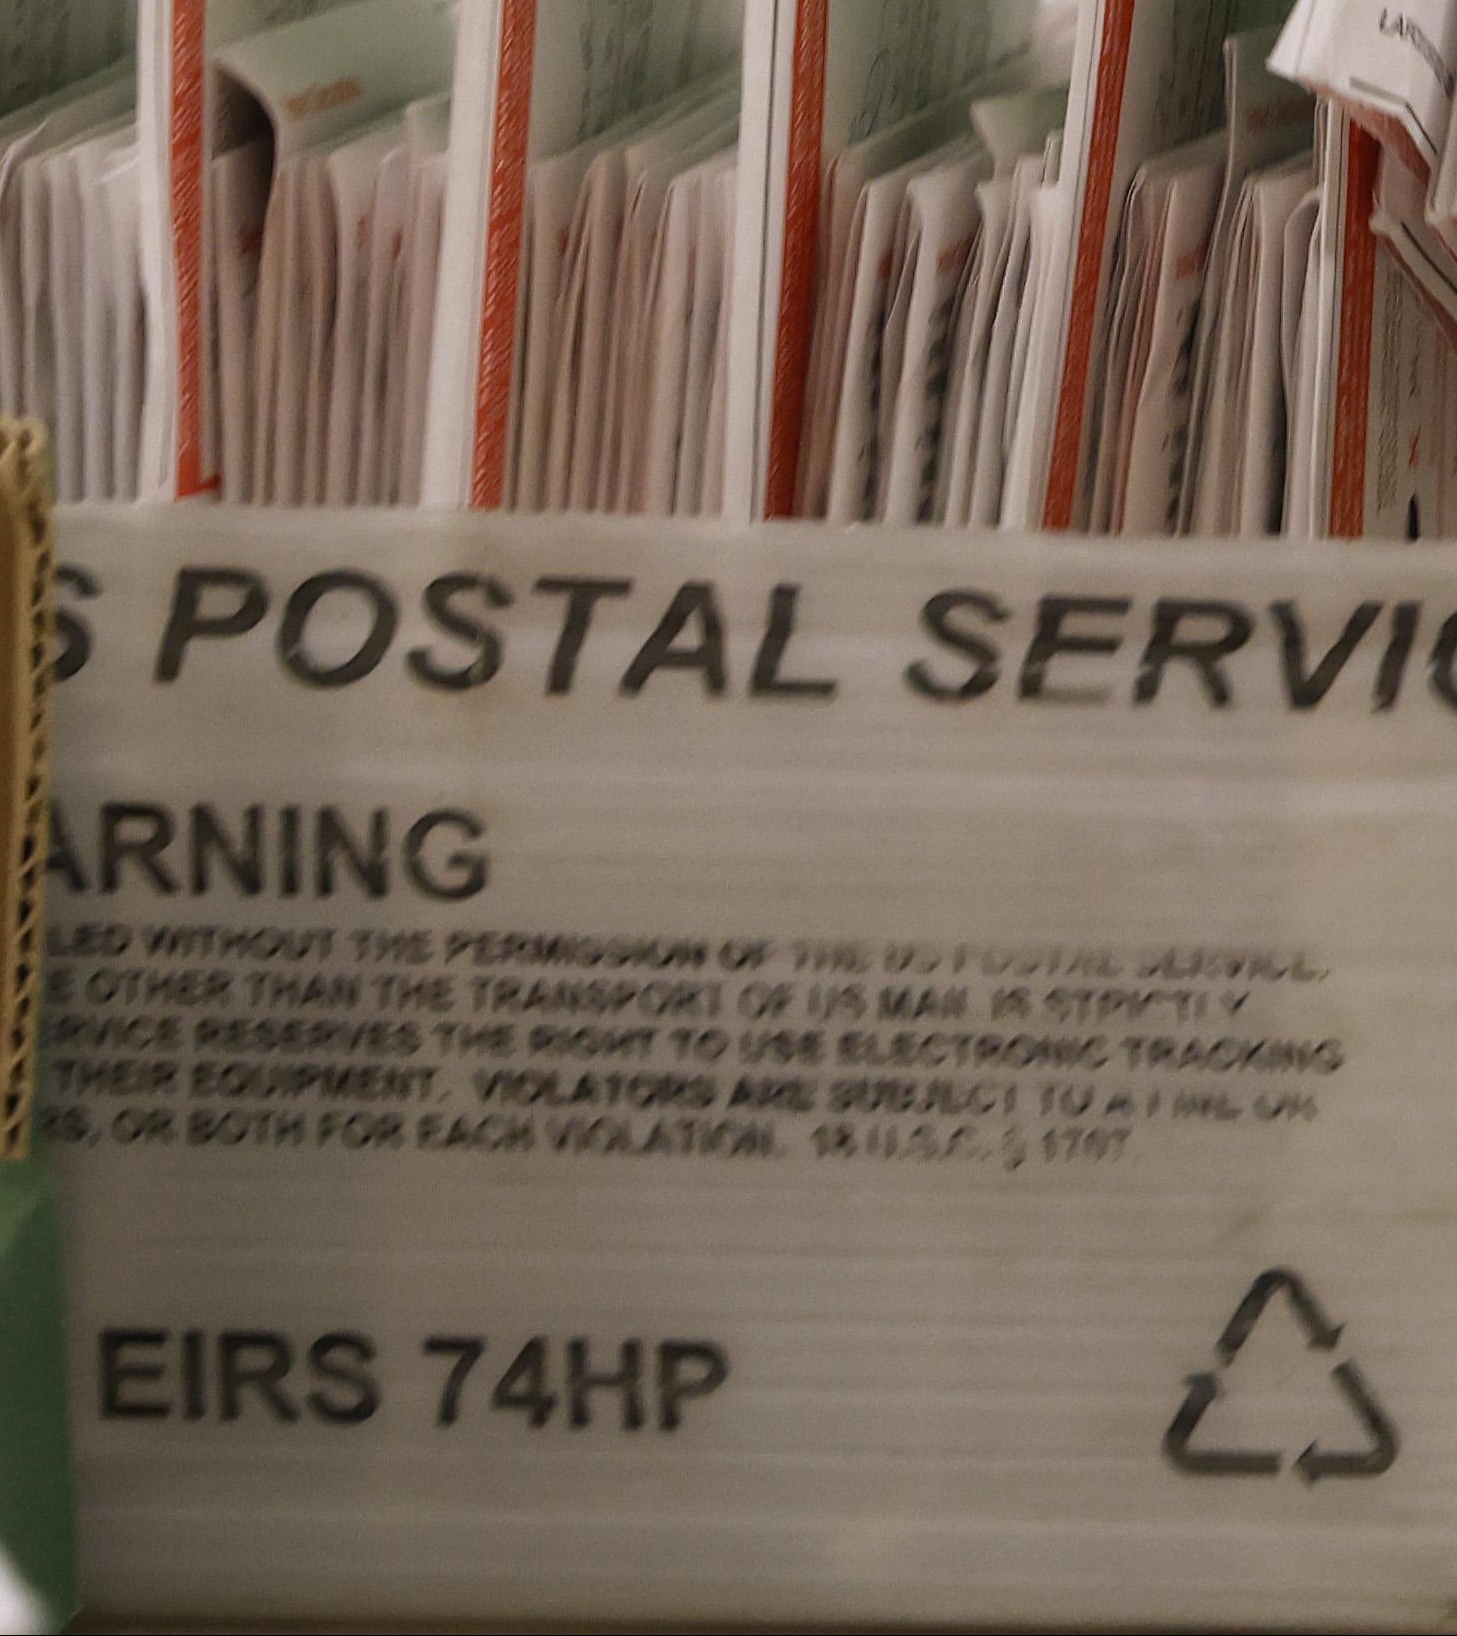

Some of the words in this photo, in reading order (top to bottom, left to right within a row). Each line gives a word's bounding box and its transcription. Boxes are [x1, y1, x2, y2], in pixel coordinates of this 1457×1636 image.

[154, 567, 839, 698] POSTAL
[145, 925, 340, 961] WITHOUT
[347, 928, 433, 964] THE
[444, 929, 711, 970] PERMISSION
[717, 935, 769, 971] OF
[85, 967, 235, 1007] OTHER
[245, 970, 361, 1009] THAN
[372, 972, 455, 1013] THE
[472, 975, 723, 1018] TRANSPORT
[736, 978, 795, 1020] OF
[807, 982, 868, 1022] US
[41, 1014, 184, 1050] RVICE
[193, 1016, 423, 1057] RESERVES
[430, 1020, 515, 1058] THE
[527, 1023, 657, 1060] RIGHT
[668, 1026, 730, 1061] TO
[739, 1027, 824, 1064] USE
[837, 1029, 1108, 1070] ELECTRONIC
[1120, 1034, 1343, 1076] TRACKING
[53, 1059, 177, 1097] THEIR
[472, 1067, 717, 1109] VIOLATORS
[727, 1070, 815, 1112] ARE
[829, 1075, 1018, 1116] SUBJECT
[111, 1106, 175, 1145] OR
[186, 1107, 306, 1146] BOTH
[315, 1109, 406, 1150] FOR
[417, 1111, 535, 1153] EACH
[99, 1325, 380, 1425] EIRS
[421, 1332, 731, 1432] 74HP
